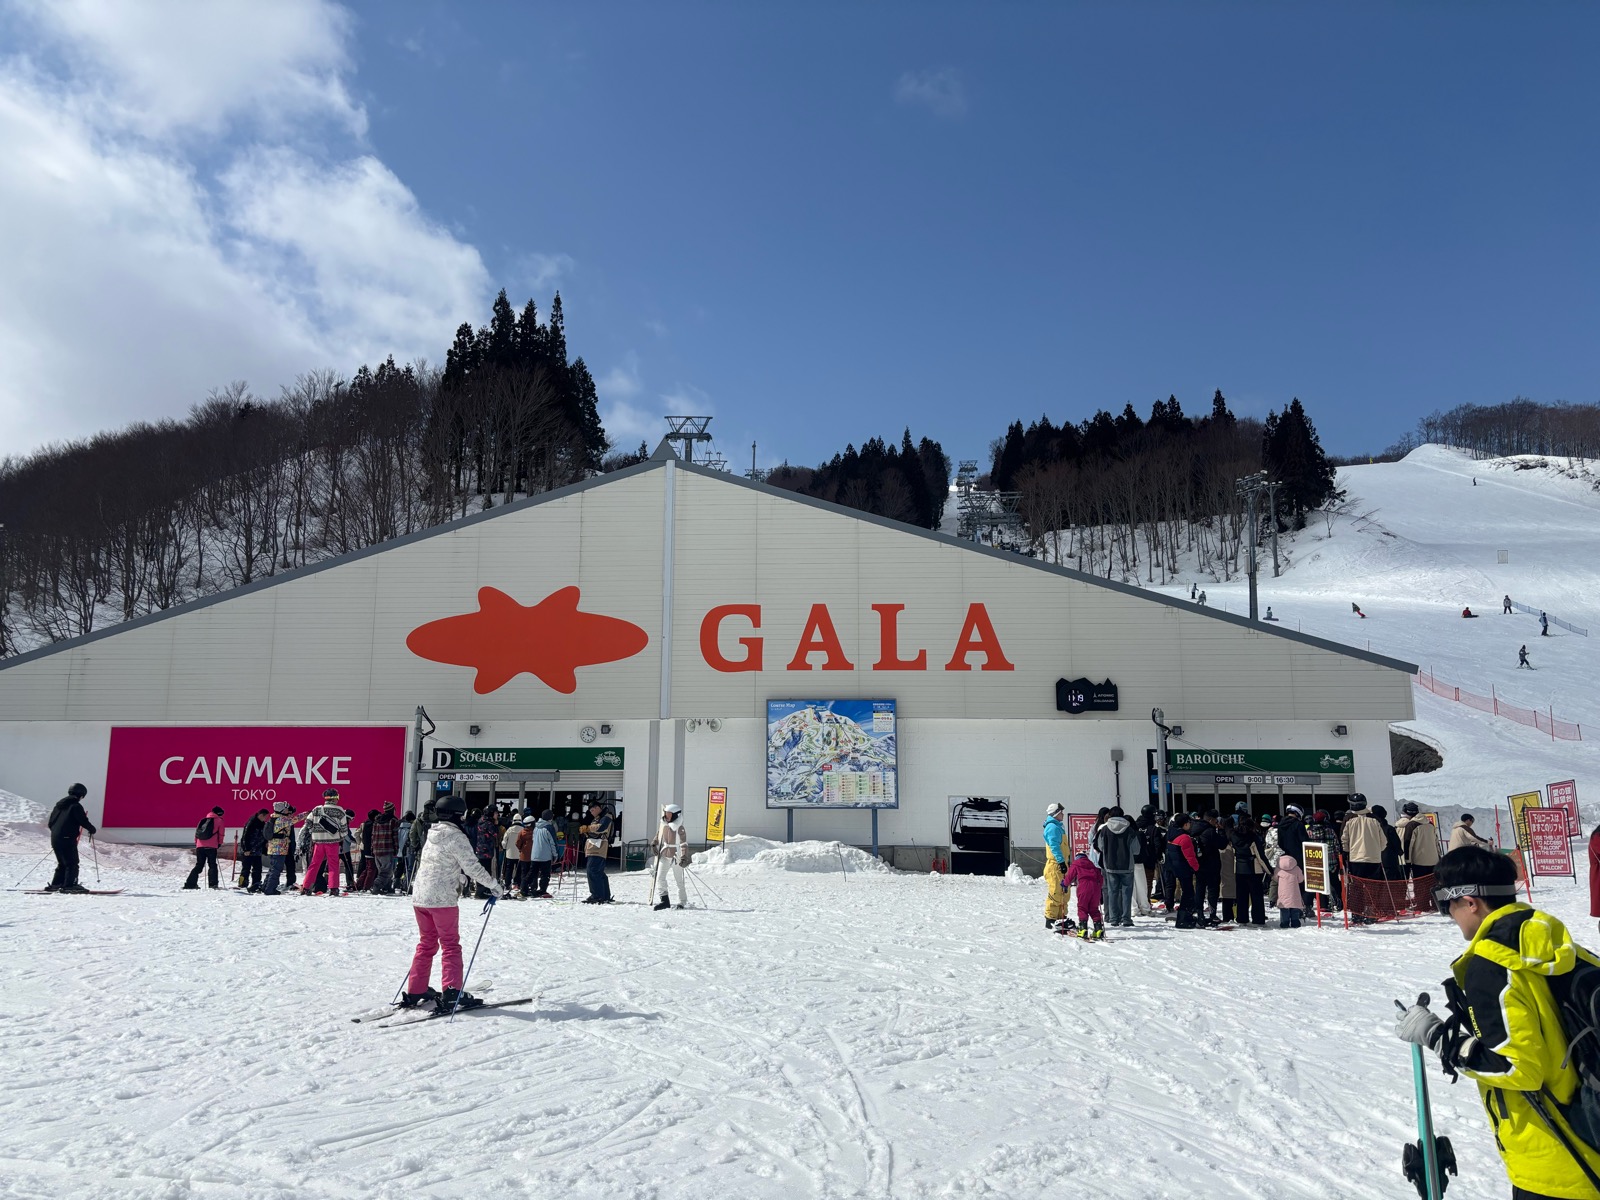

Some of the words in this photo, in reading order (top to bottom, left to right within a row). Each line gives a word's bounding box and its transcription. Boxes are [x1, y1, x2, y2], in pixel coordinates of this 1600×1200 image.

[700, 603, 1014, 673] GALA
[435, 751, 451, 768] D
[459, 752, 516, 762] SOCIABLE
[1176, 754, 1245, 764] BAROUCHE
[159, 756, 352, 784] CANMAKE
[232, 789, 276, 800] TOKYO
[1305, 849, 1323, 858] 15:00
[1468, 1006, 1482, 1038] DESCENTE
